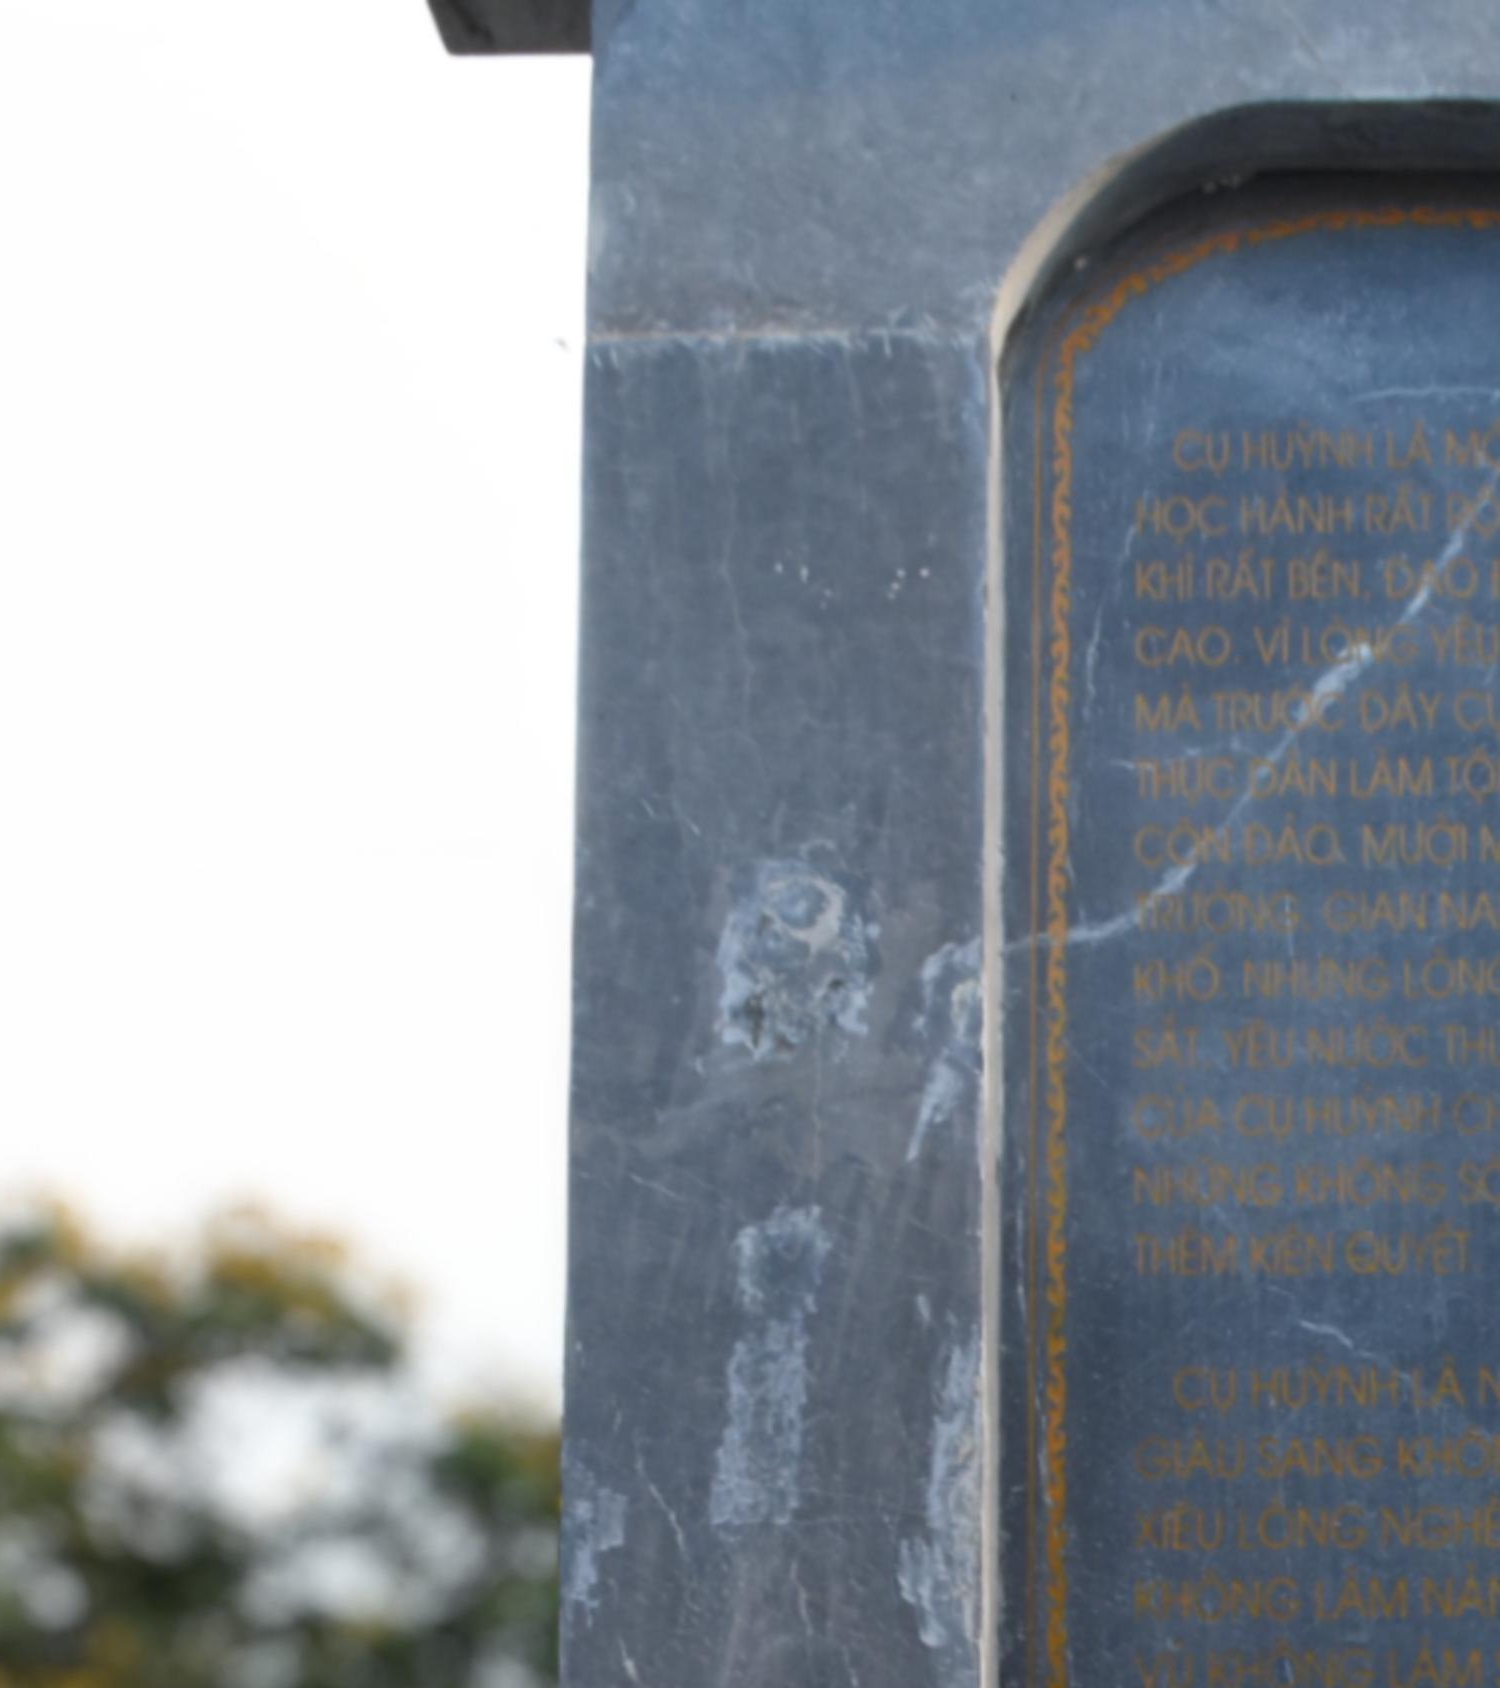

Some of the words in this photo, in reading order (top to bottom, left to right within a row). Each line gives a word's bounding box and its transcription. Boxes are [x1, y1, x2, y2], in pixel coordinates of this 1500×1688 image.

[1173, 428, 1231, 474] CỤ
[1387, 419, 1432, 470] LÀ
[1135, 495, 1225, 544] HỌC
[1243, 490, 1352, 533] HÀNH
[1367, 483, 1432, 532] RẤT
[1135, 552, 1193, 600] KHÍ
[1208, 549, 1274, 596] RẤT
[1255, 619, 1288, 663] VÌ
[1433, 614, 1499, 664] YÊU
[1135, 681, 1200, 732] MÀ
[1359, 682, 1442, 732] ĐÂY
[1136, 757, 1232, 804] THỰC
[1251, 749, 1337, 798] DÂN
[1350, 749, 1432, 799] LÀM
[1134, 816, 1231, 869] CÔN
[1325, 891, 1426, 932] GIAN
[1225, 1018, 1293, 1069] YÊU
[1308, 1017, 1426, 1067] NƯỚC
[1133, 1084, 1220, 1140] CỦA
[1235, 1094, 1293, 1142] CỤ
[1135, 1225, 1238, 1276] THÊM
[1249, 1225, 1335, 1277] KIÊN
[1173, 1366, 1238, 1415] CỤ
[1410, 1354, 1466, 1407] LÀ
[1136, 1425, 1244, 1480] GIÀU
[1258, 1434, 1384, 1478] SANG
[1239, 1497, 1367, 1550] LÒNG
[1316, 1567, 1408, 1620] LÀM
